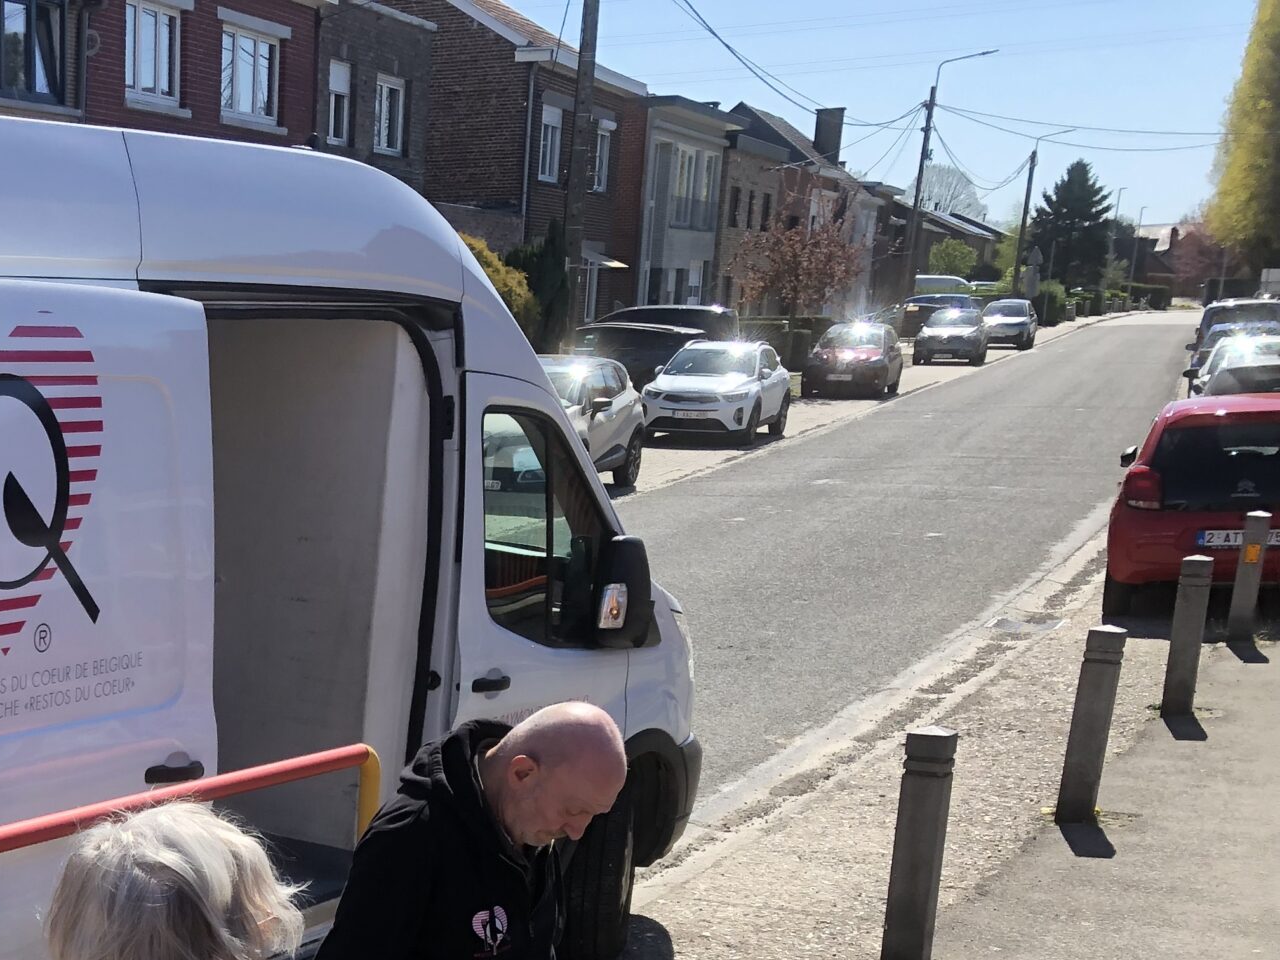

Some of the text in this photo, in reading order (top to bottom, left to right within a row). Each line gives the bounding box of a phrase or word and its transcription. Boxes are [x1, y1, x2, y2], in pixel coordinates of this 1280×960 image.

[11, 675, 27, 692] DU
[32, 665, 71, 688] COEUR
[75, 662, 89, 680] DE
[92, 651, 143, 676] BELGIQUE
[75, 685, 91, 703] DU
